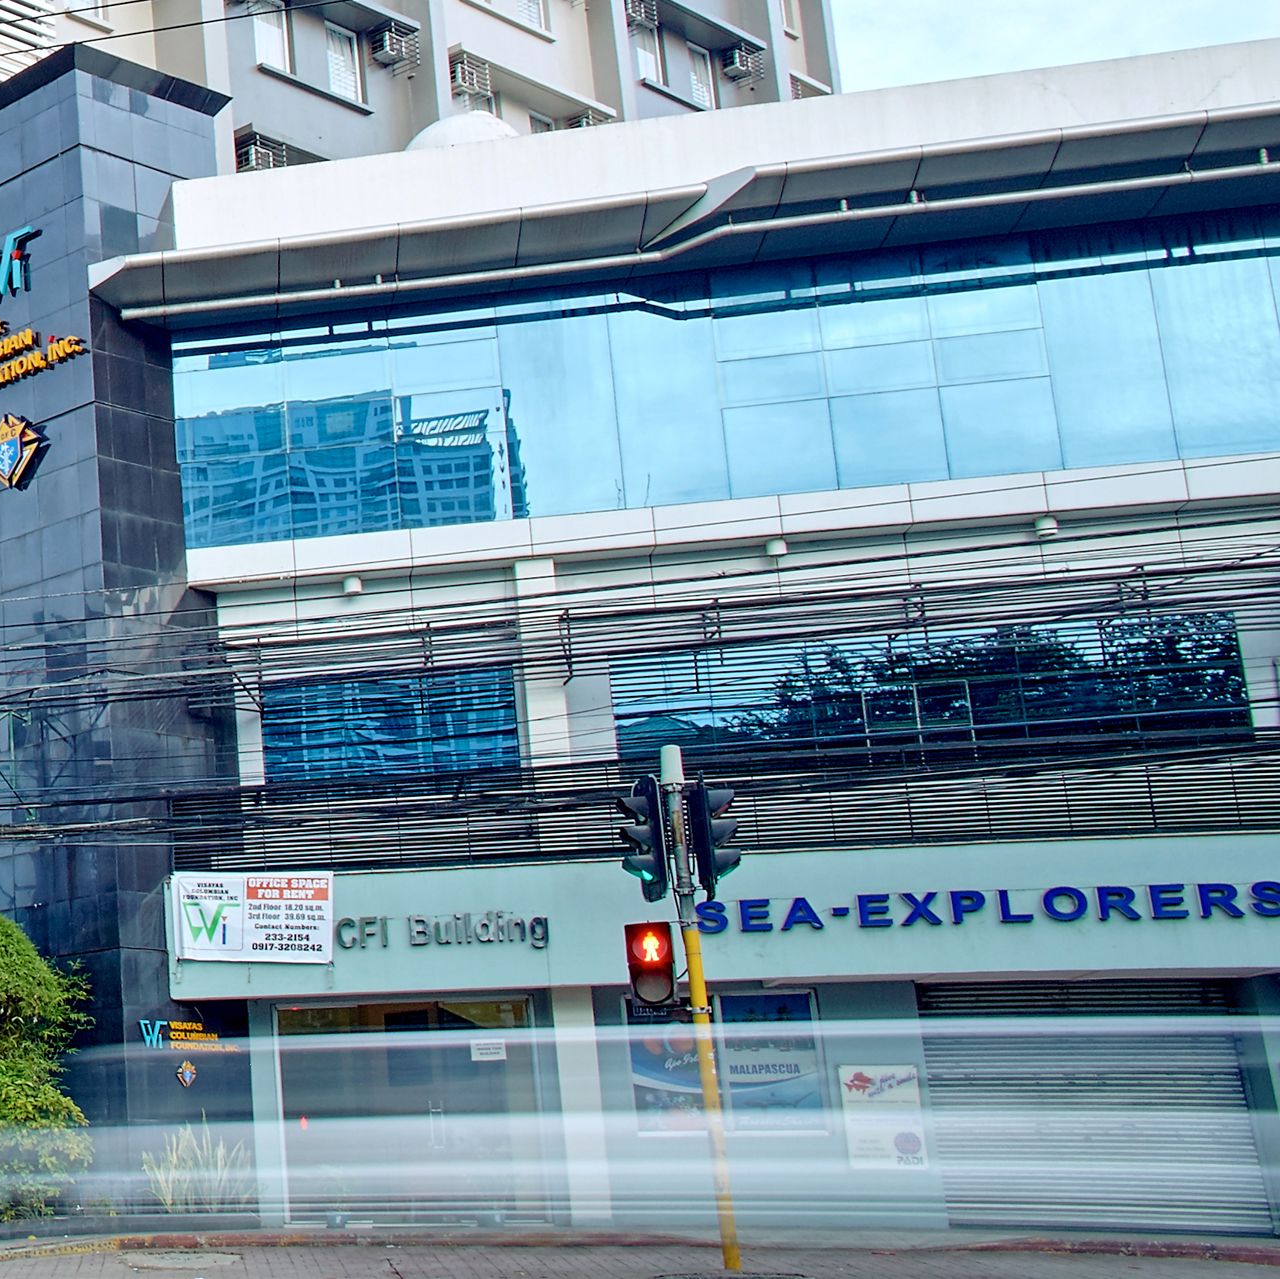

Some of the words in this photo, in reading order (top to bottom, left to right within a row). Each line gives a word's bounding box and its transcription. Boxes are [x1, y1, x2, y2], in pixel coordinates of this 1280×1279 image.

[248, 878, 289, 888] OFFICE
[291, 878, 328, 888] SPACE
[258, 889, 281, 899] FOR
[283, 889, 315, 899] RENT
[248, 903, 262, 911] 2nd
[263, 903, 282, 911] Floor
[284, 903, 303, 911] 18.20
[695, 880, 1280, 934] SEA-EXPLORERS
[247, 912, 262, 920] 3rd
[261, 912, 280, 920] Floor
[284, 912, 305, 920] 39.69
[335, 916, 389, 949] CFI
[408, 911, 550, 949] Building
[265, 933, 310, 942] 233-2154
[251, 942, 323, 952] 0917-3208242
[169, 1020, 203, 1030] VISAYAS
[169, 1031, 218, 1041] COLUMBIAN
[729, 1064, 801, 1075] MALAPASCUA
